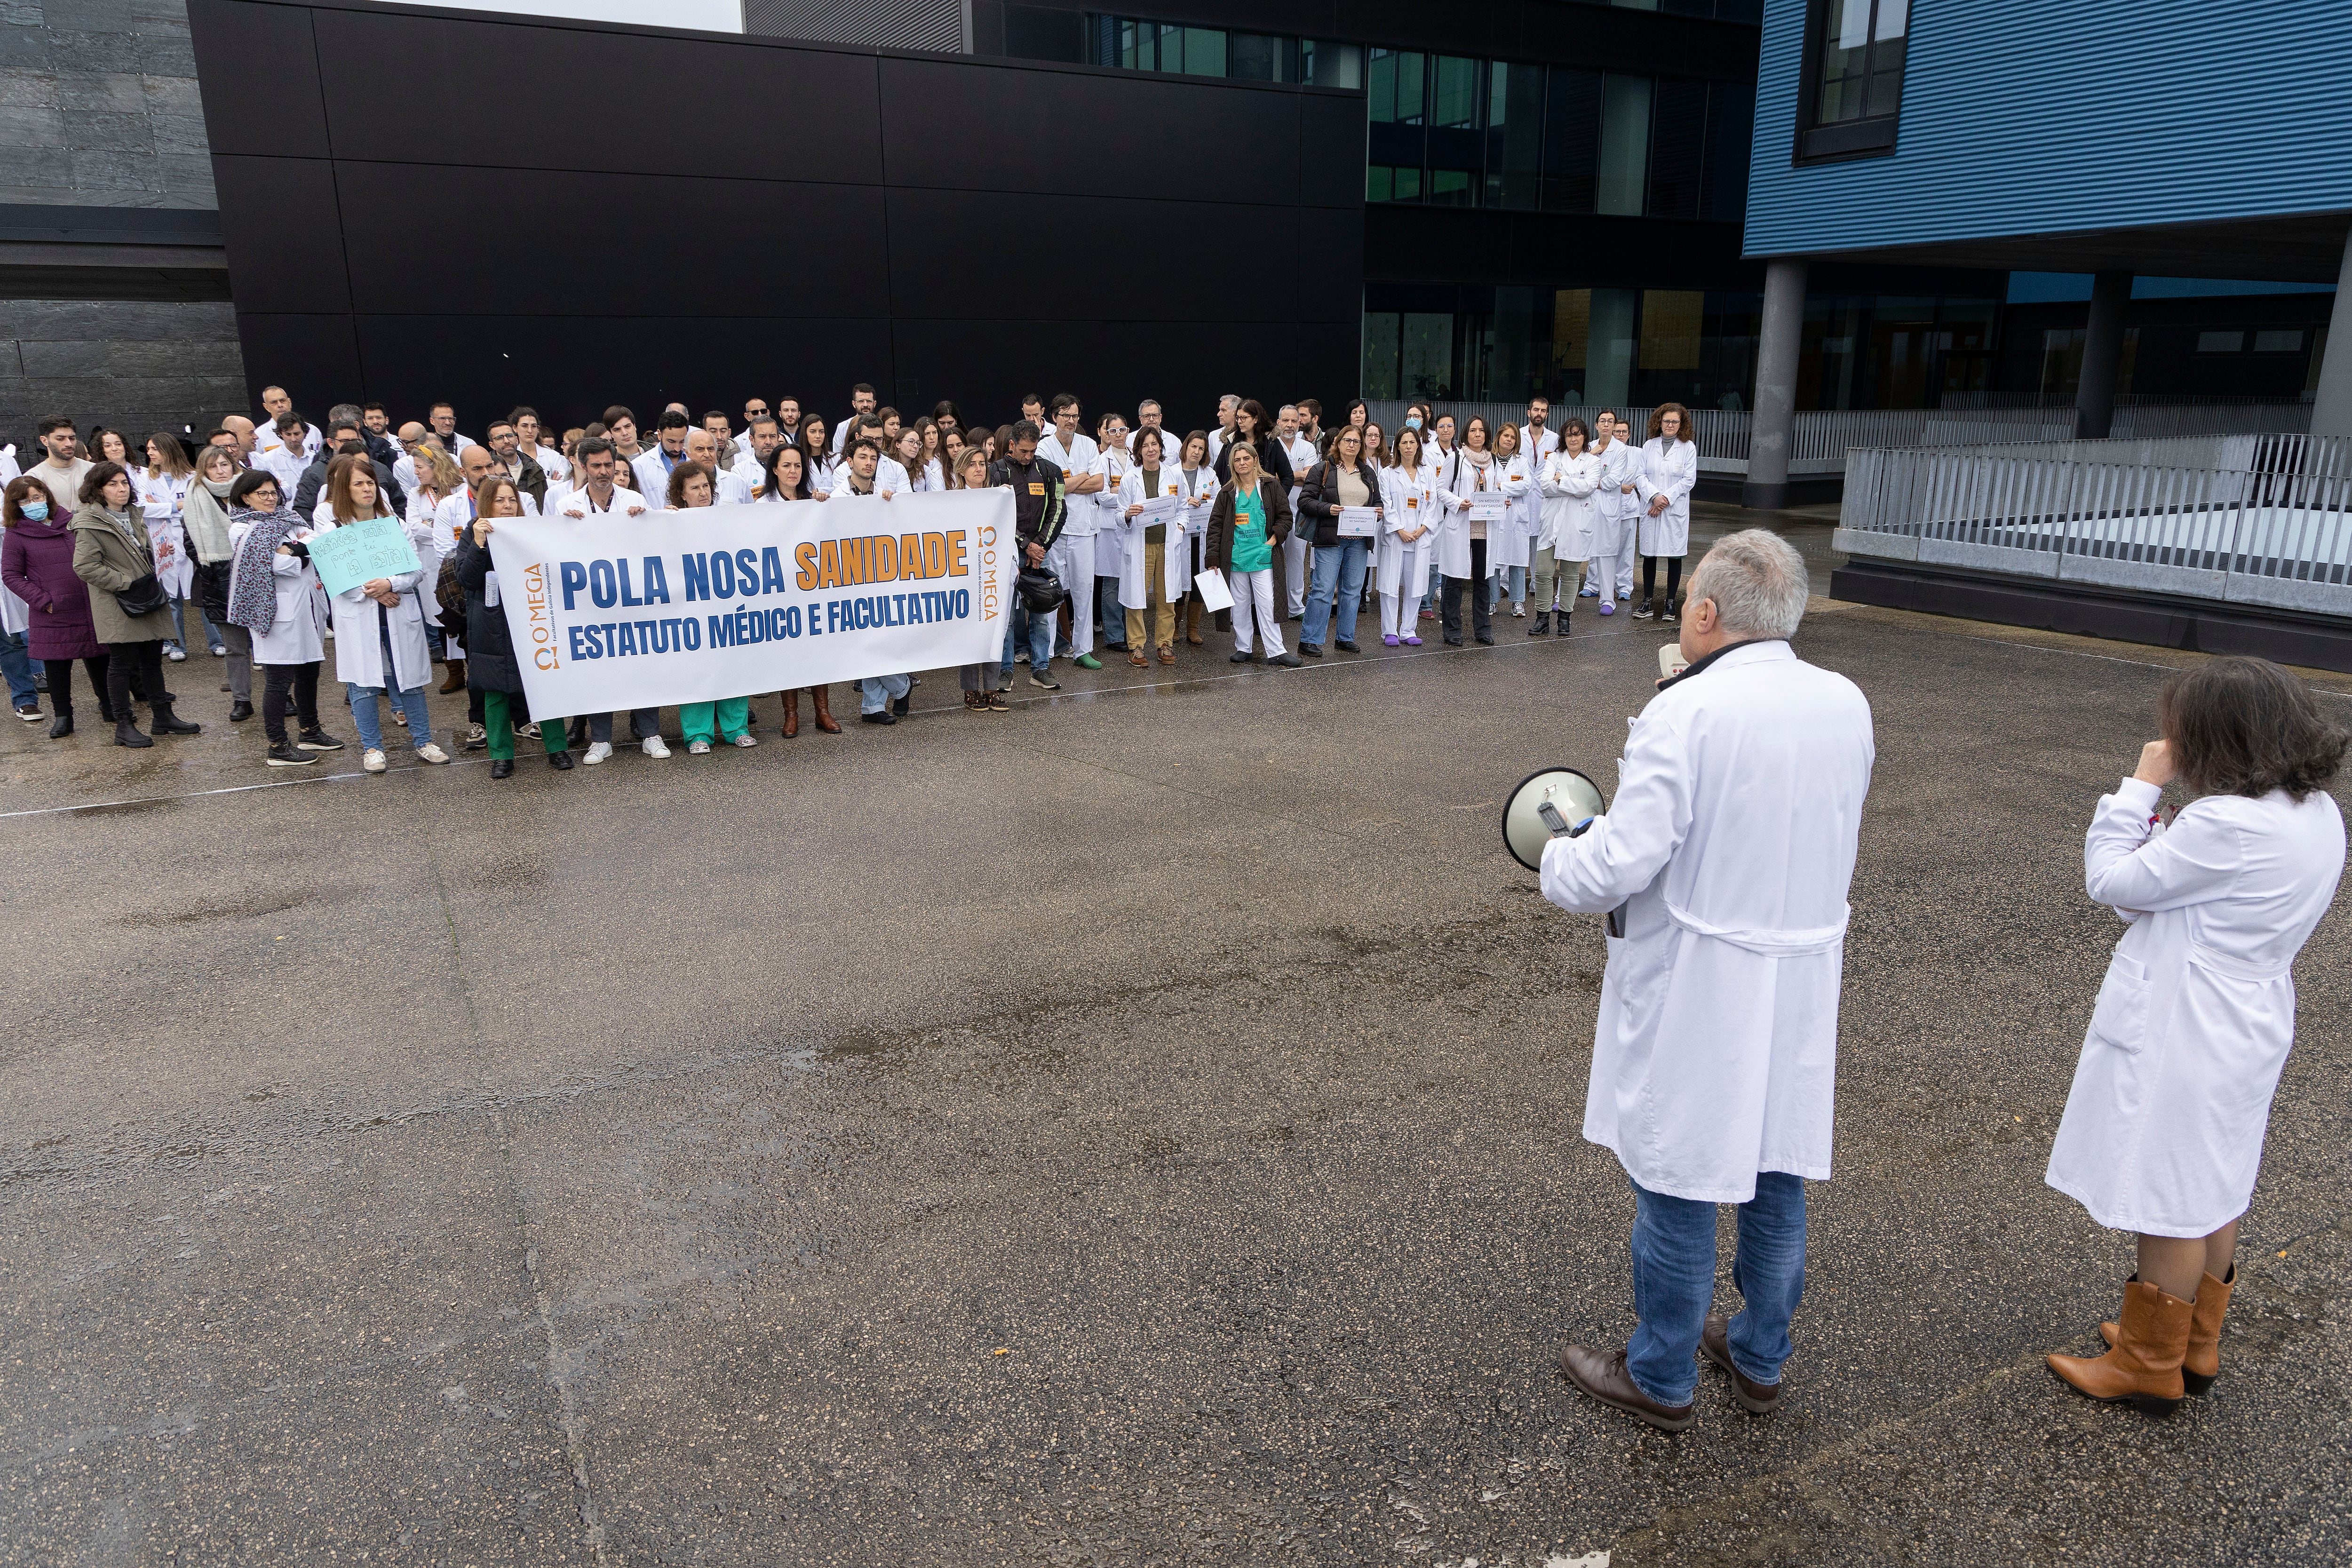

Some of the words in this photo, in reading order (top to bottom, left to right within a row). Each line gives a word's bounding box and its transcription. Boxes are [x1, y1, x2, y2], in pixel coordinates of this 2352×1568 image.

[331, 547, 357, 568] ponte
[363, 541, 376, 551] tú
[560, 556, 670, 611] POLA
[682, 546, 785, 602] NOSA
[795, 530, 969, 591] SANIDADE
[568, 617, 701, 661] ESTATUTO
[708, 603, 802, 649] MÉDICO
[808, 603, 822, 636] E
[827, 589, 969, 634] FACULTATIVO
